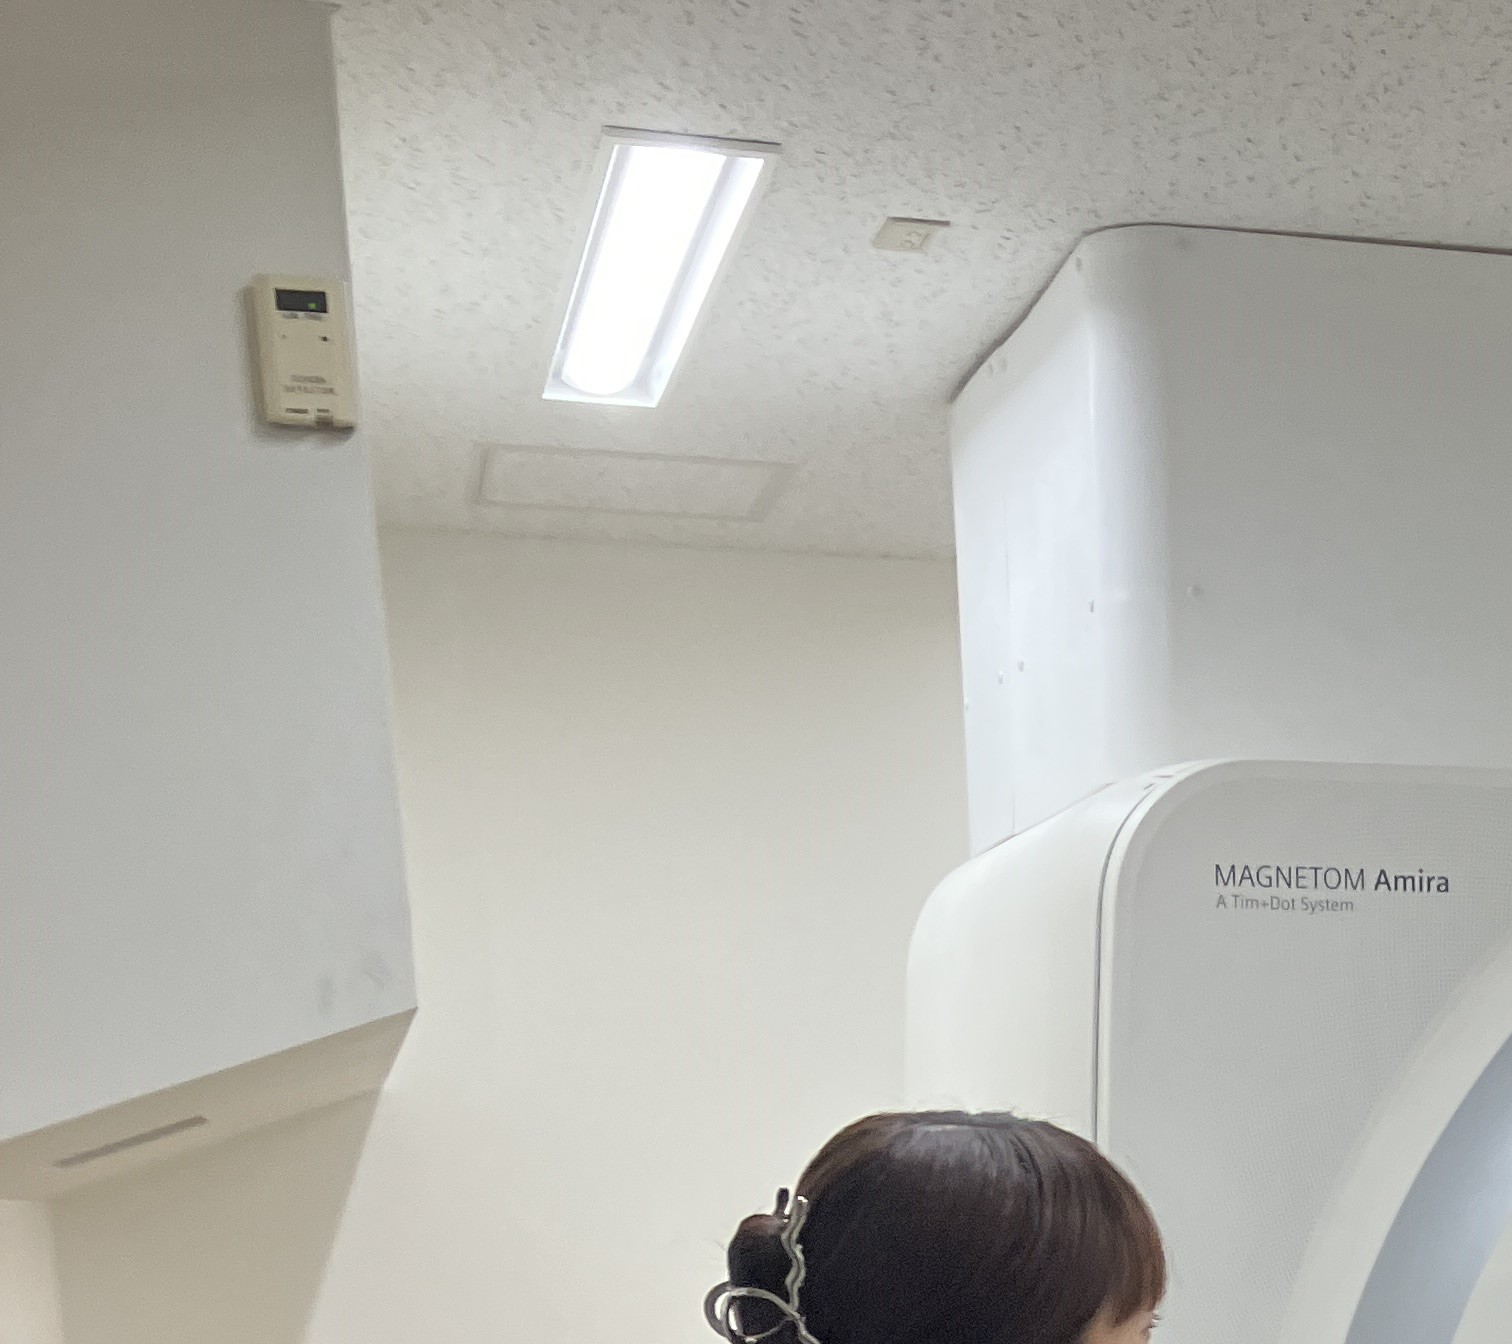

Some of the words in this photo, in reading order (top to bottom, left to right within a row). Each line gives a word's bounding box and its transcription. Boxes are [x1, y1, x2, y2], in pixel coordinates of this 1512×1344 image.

[1214, 863, 1366, 891] MAGNETOM
[1374, 868, 1450, 893] Amira
[1216, 895, 1227, 910] A
[1231, 894, 1296, 911] Tim+Dot
[1300, 896, 1354, 915] System
